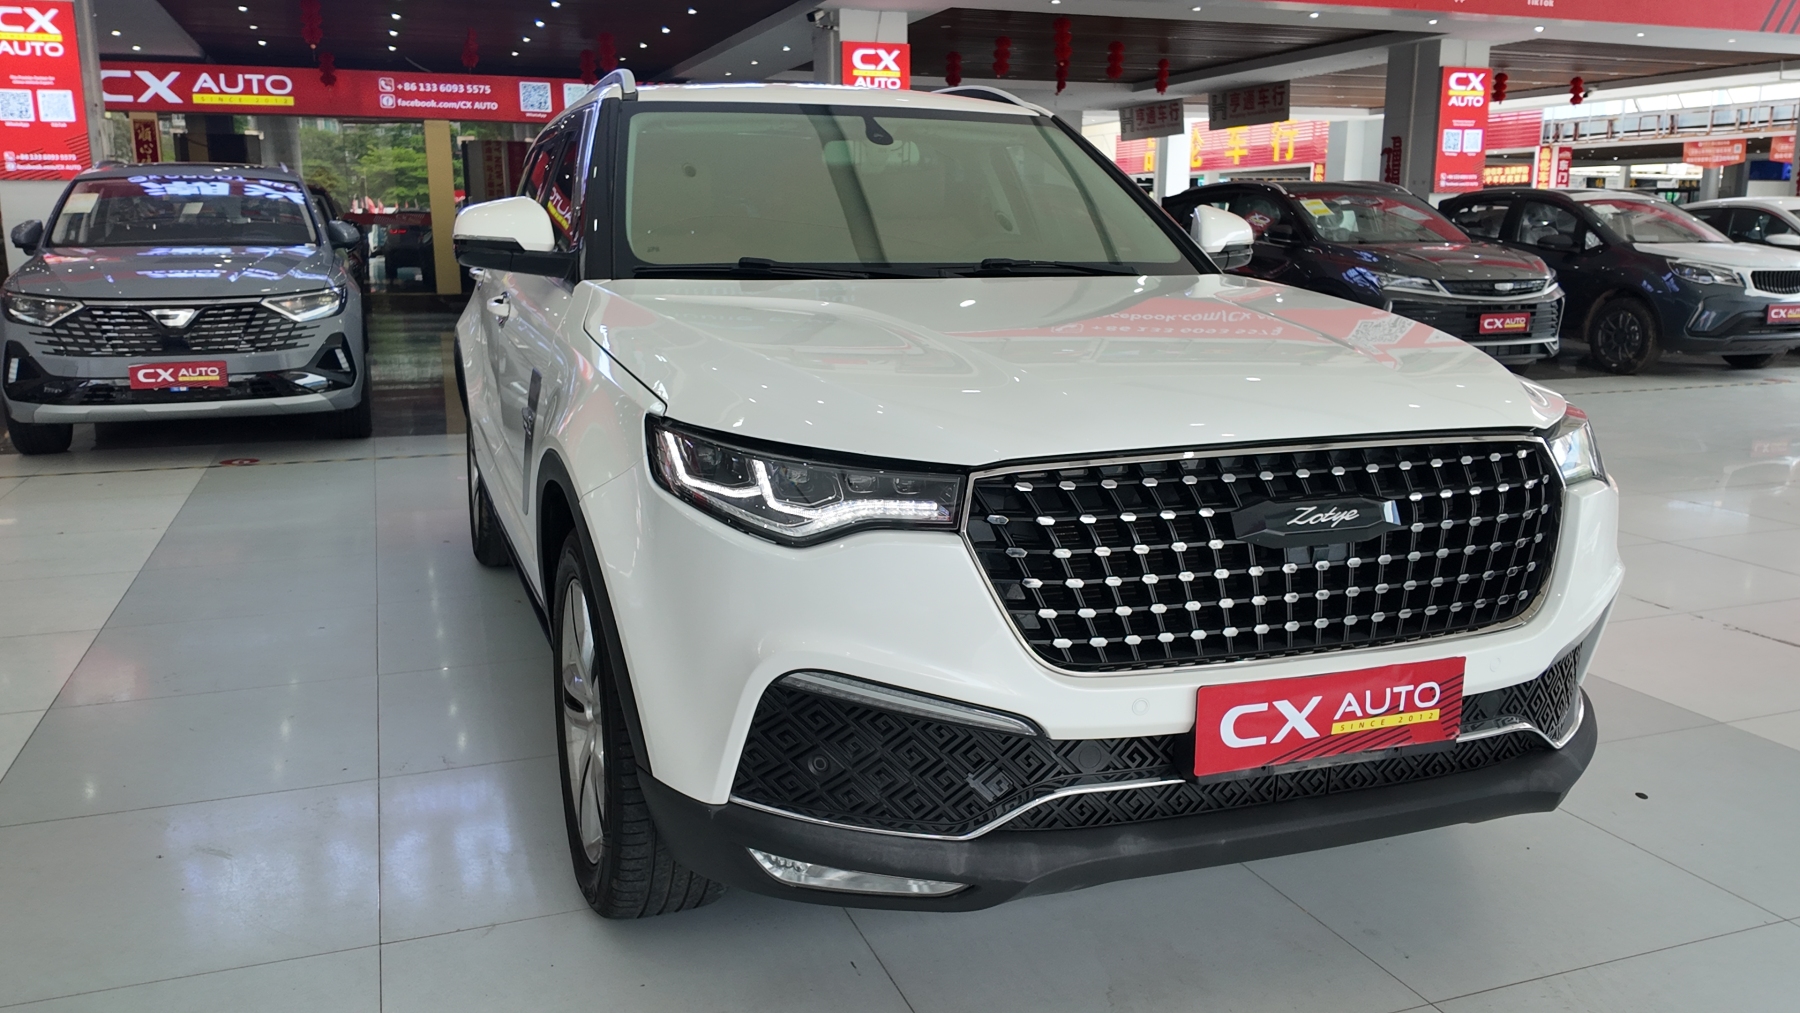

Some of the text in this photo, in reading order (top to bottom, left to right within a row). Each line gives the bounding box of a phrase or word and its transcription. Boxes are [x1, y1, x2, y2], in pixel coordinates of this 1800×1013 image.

[0, 6, 61, 35] CX
[0, 40, 64, 57] AUTO
[851, 48, 901, 71] CX
[101, 69, 293, 104] CX AUTO
[397, 82, 491, 94] +86 133 6093 5575
[853, 76, 901, 89] AUTO
[1448, 72, 1486, 91] CX
[397, 98, 498, 110] facebook.com/CX AUTO
[1447, 96, 1484, 107] AUTO
[1770, 308, 1788, 319] CX
[1483, 318, 1504, 329] CX
[1504, 317, 1526, 325] AUTO
[137, 368, 176, 383] CX
[178, 367, 219, 377] AUTO
[1286, 505, 1360, 528] Zotye
[1219, 681, 1441, 748] CX AUTO
[1340, 711, 1435, 732] SINCE 2012
